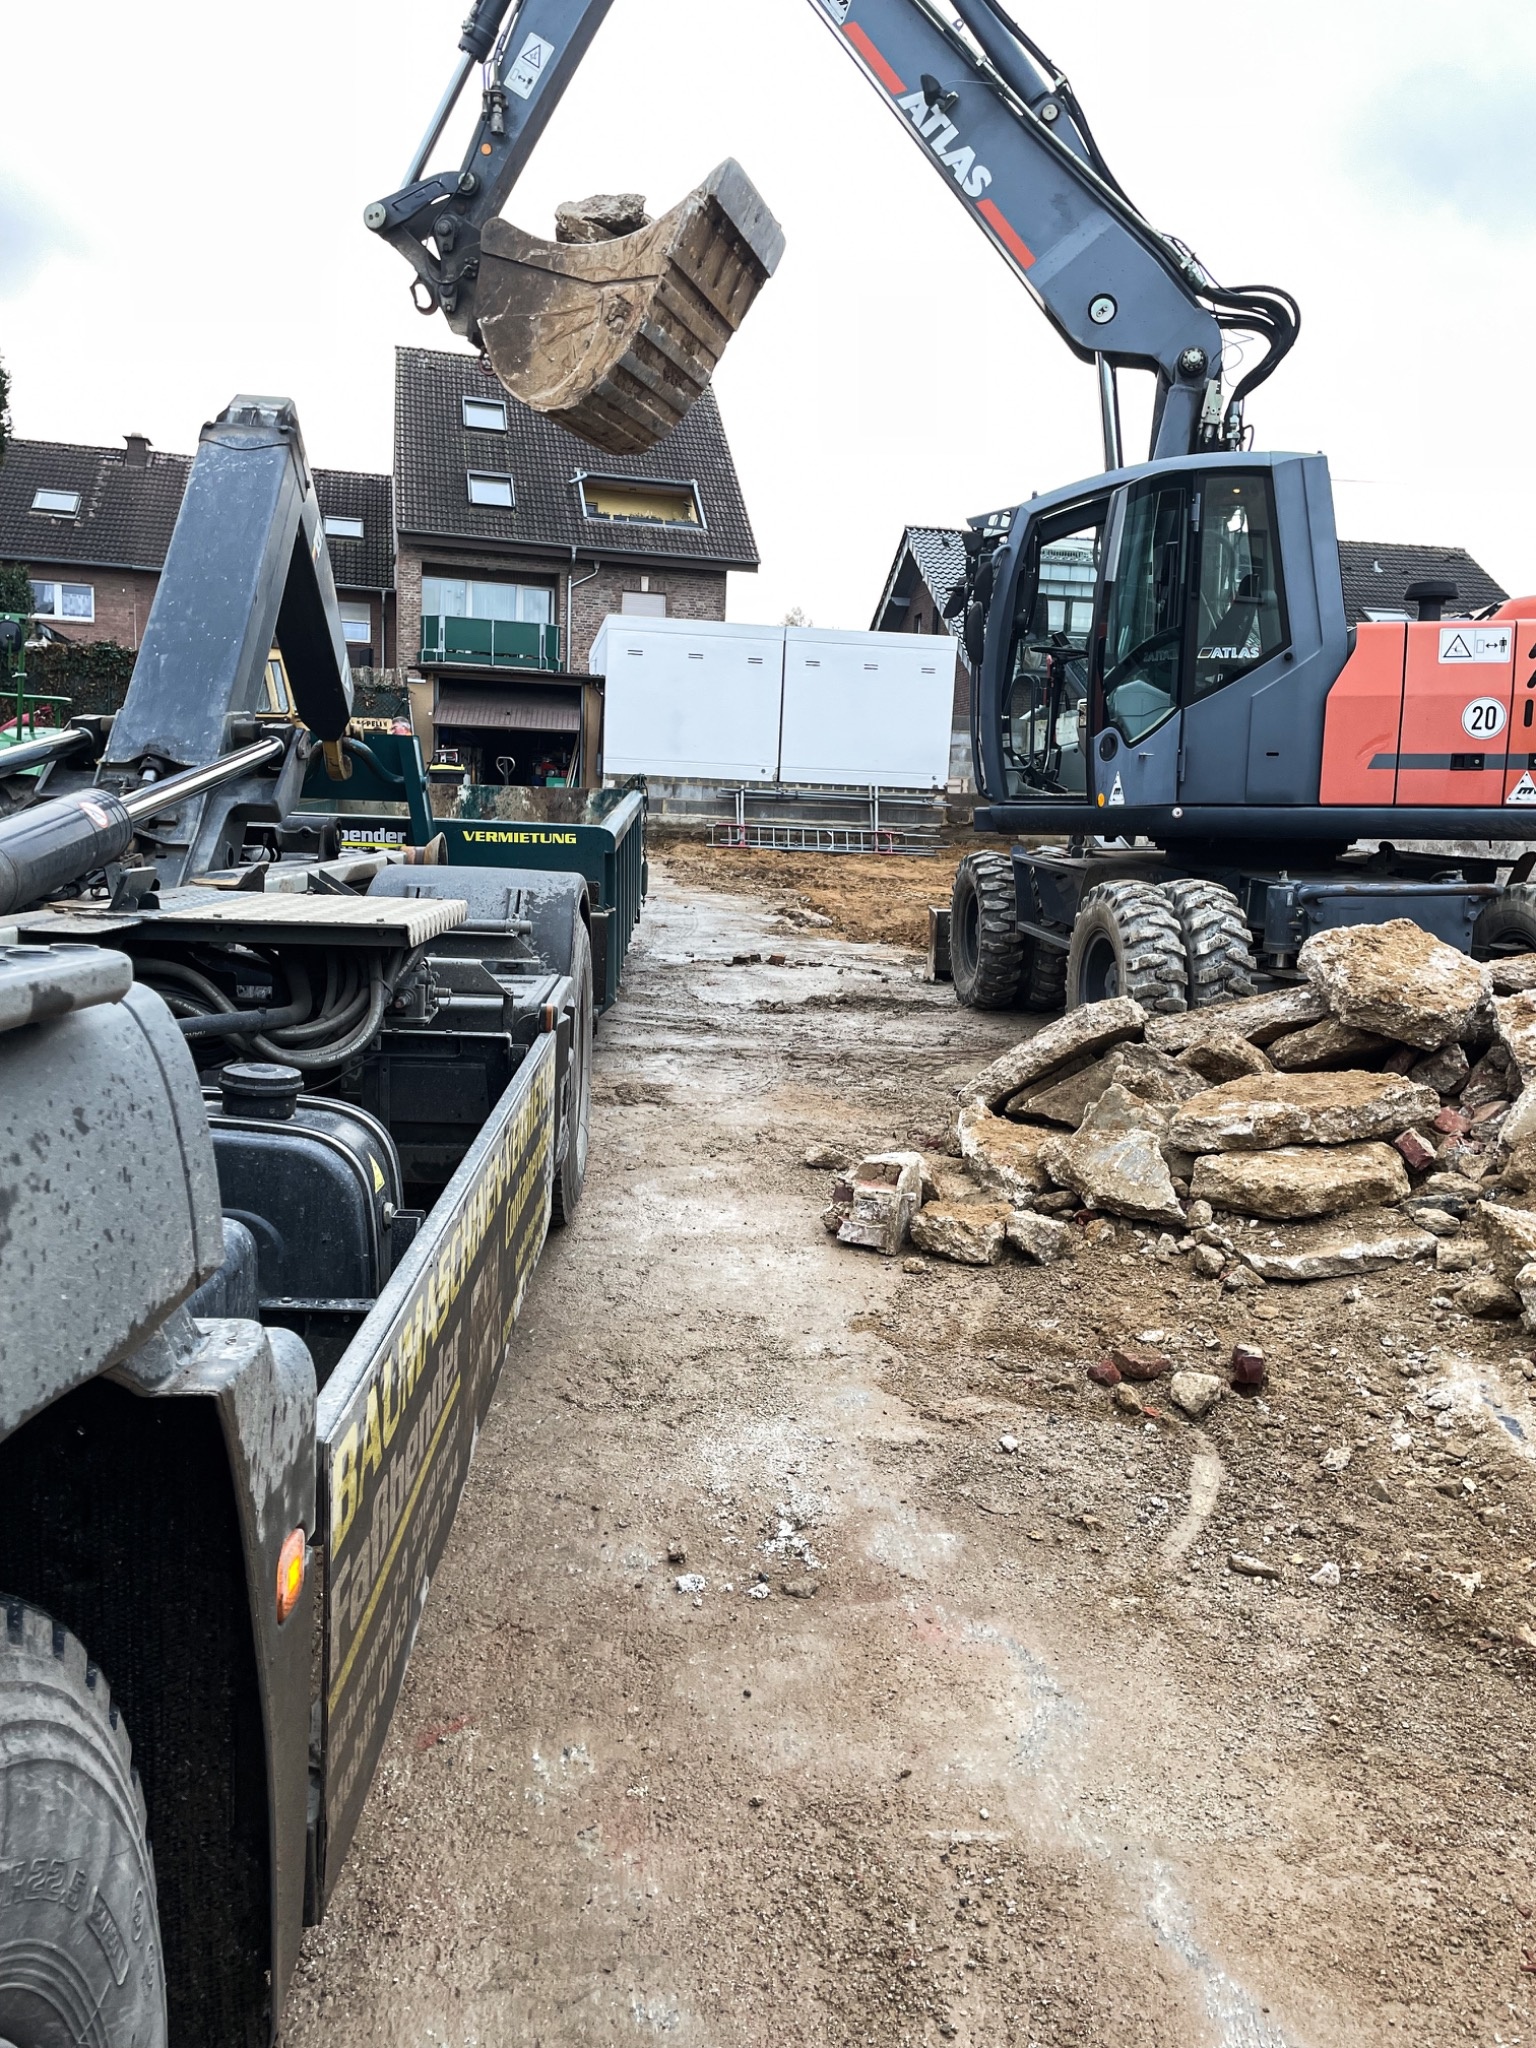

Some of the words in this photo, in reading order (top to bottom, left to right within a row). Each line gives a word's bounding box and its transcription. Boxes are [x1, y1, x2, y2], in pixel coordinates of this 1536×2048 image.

[897, 91, 992, 197] ATLAS
[1210, 647, 1260, 659] ATLAS
[1471, 706, 1497, 730] 20
[462, 830, 577, 844] VERMIETUNG
[330, 1319, 461, 1678] Faßbender
